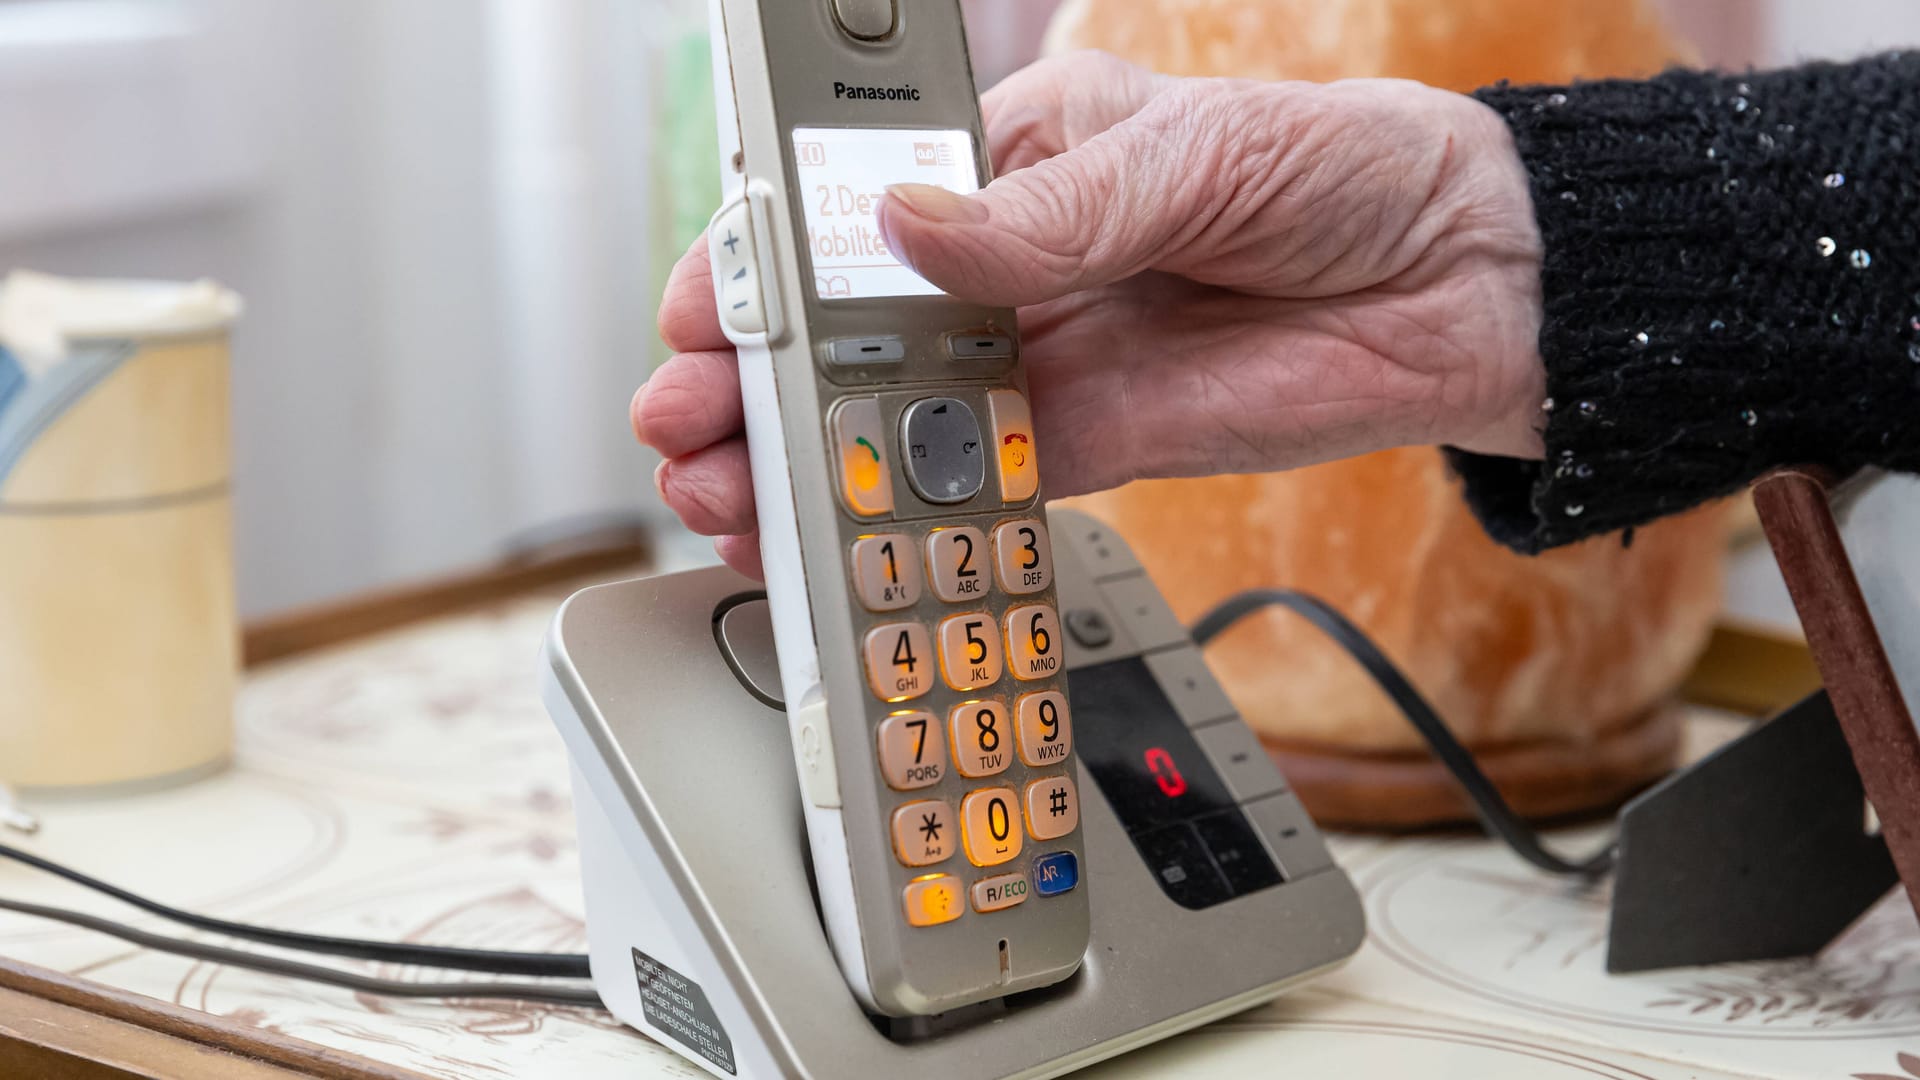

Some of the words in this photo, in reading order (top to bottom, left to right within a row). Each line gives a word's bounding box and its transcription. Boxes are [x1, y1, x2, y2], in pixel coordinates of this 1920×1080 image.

[833, 82, 921, 102] Panasonic
[816, 184, 833, 217] 2
[809, 224, 888, 257] obilte
[880, 541, 898, 584] 1
[953, 534, 977, 578] 2
[1018, 527, 1040, 570] 3
[957, 579, 981, 594] ABC
[1023, 571, 1043, 586] DEF
[892, 630, 917, 673] 4
[965, 621, 987, 665] 5
[1030, 612, 1051, 655] 6
[896, 676, 919, 692] GHI
[970, 667, 990, 682] JKL
[1030, 656, 1056, 673] MNO
[976, 708, 1000, 752] 8
[1038, 699, 1059, 743] 9
[905, 719, 928, 764] 7
[1037, 743, 1066, 761] WXYZ
[907, 765, 940, 783] PQRS
[979, 754, 1002, 771] TUV
[1143, 747, 1188, 798] 0
[987, 797, 1010, 842] 0
[986, 880, 1027, 902] R/ECO
[634, 954, 669, 983] MOBILTEIL
[667, 974, 688, 994] NICHT
[638, 970, 650, 985] MIT
[641, 986, 712, 1036] HEADSET-ANSCHLUSS
[711, 1028, 720, 1041] IN
[644, 1001, 656, 1017] DIE
[655, 1008, 698, 1042] LADESCHALE
